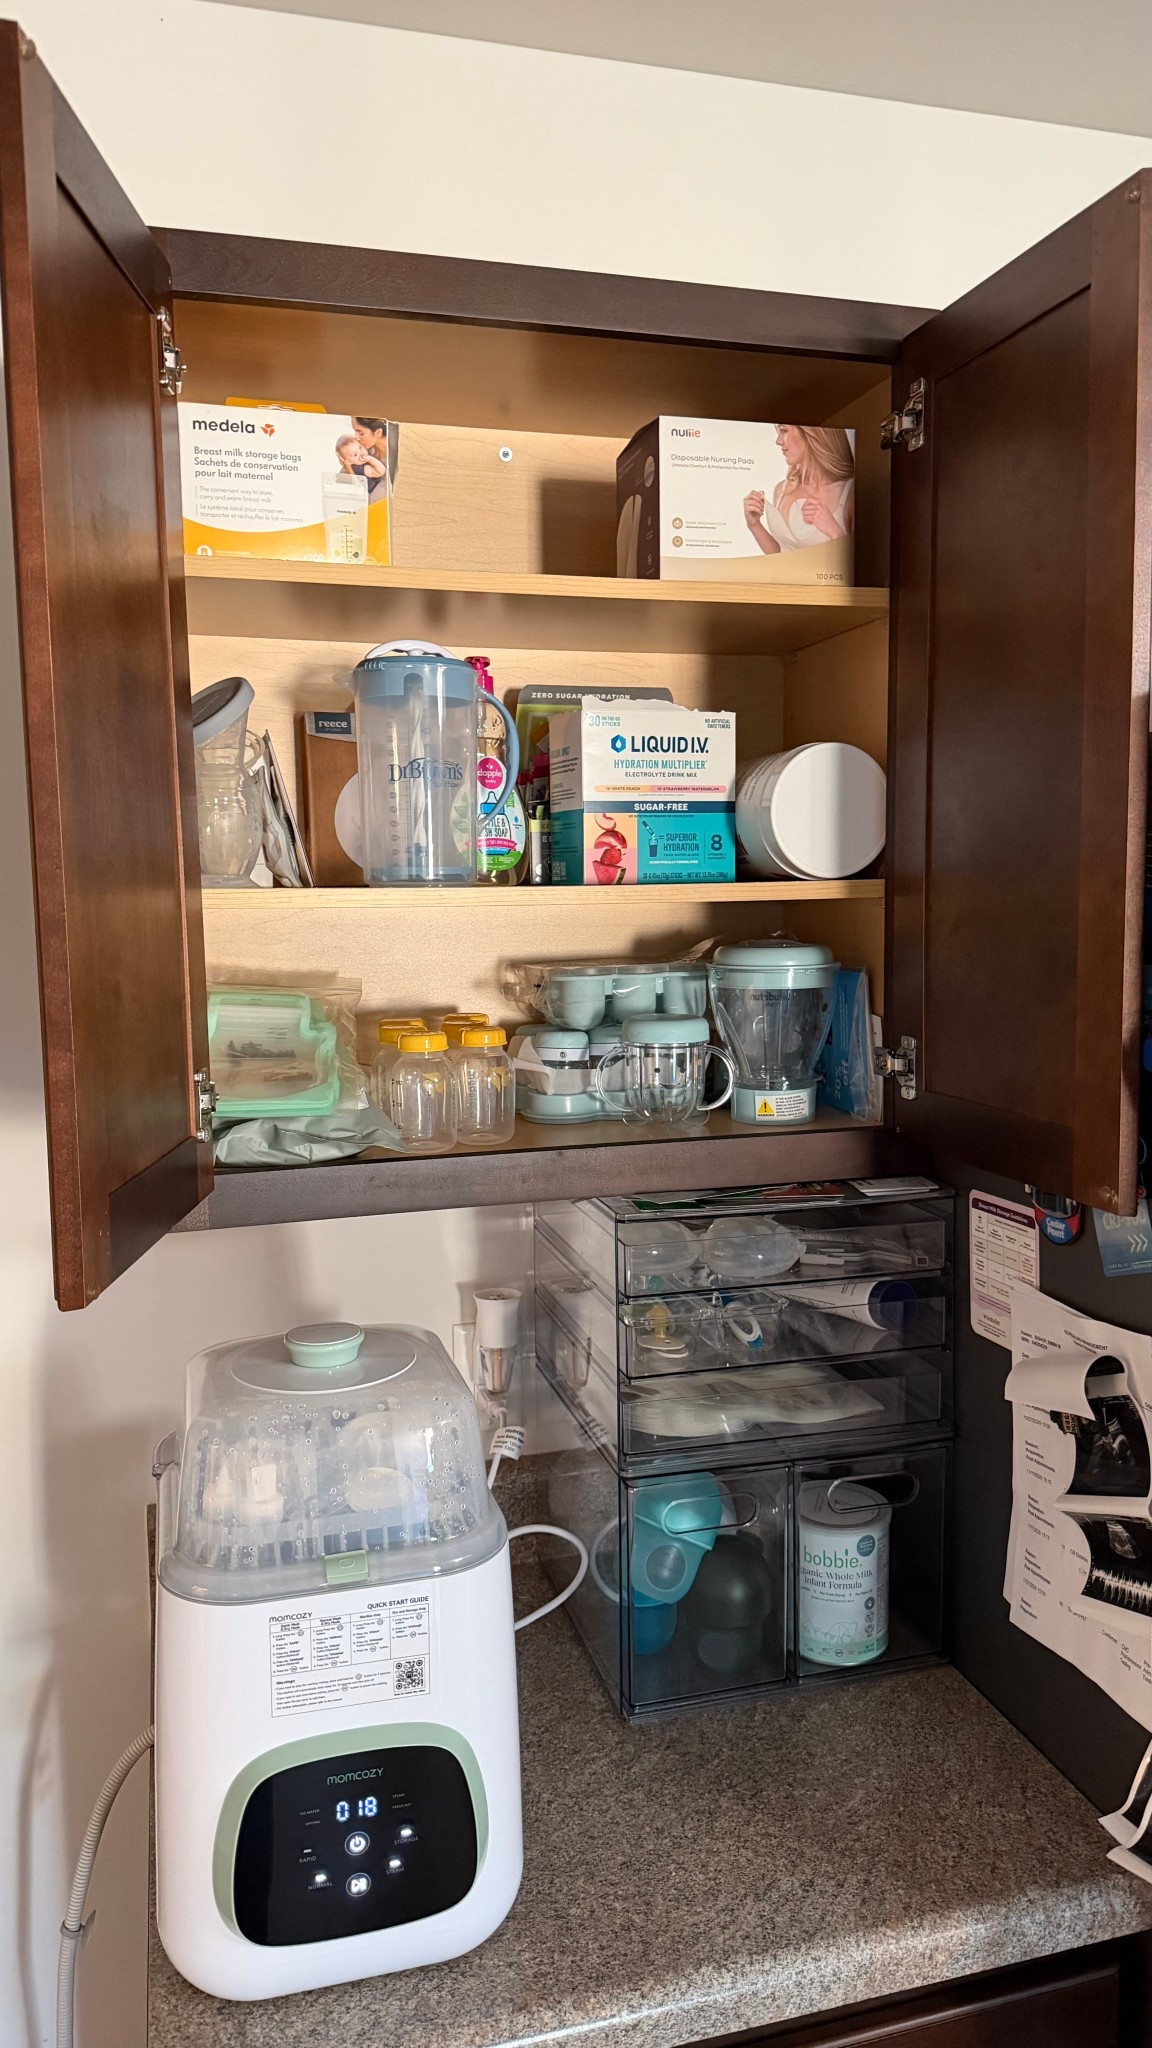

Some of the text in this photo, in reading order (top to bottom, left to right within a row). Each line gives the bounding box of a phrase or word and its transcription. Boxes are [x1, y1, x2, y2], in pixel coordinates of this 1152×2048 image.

[192, 419, 255, 434] medela
[194, 446, 302, 463] Breast milk storage bags
[670, 453, 755, 465] Disposable Nursing Pads
[194, 457, 299, 472] Sachets de conservation
[195, 469, 273, 481] pour lait maternel
[829, 573, 843, 581] PCS
[318, 720, 347, 728] reece
[589, 715, 600, 727] 30
[631, 735, 709, 753] LIQUID I.V.
[614, 759, 706, 770] HYDRATION MULTIPLIER
[477, 769, 502, 778] dapple
[634, 803, 689, 811] SUGAR-FREE
[665, 833, 697, 842] SUPERIOR
[711, 834, 723, 851] 8
[663, 843, 699, 851] HYDRATION
[1047, 1226, 1065, 1239] Point
[804, 1544, 859, 1569] bobbie
[826, 1572, 854, 1580] Whole
[857, 1569, 873, 1578] Milk
[804, 1576, 826, 1588] Infant
[829, 1581, 862, 1590] Formula
[367, 1596, 429, 1610] QUICK START GUIDE
[336, 1796, 378, 1822] 018
[394, 1836, 419, 1845] STORAGE
[386, 1867, 405, 1875] STEAM
[307, 1881, 333, 1891] NORMAL
